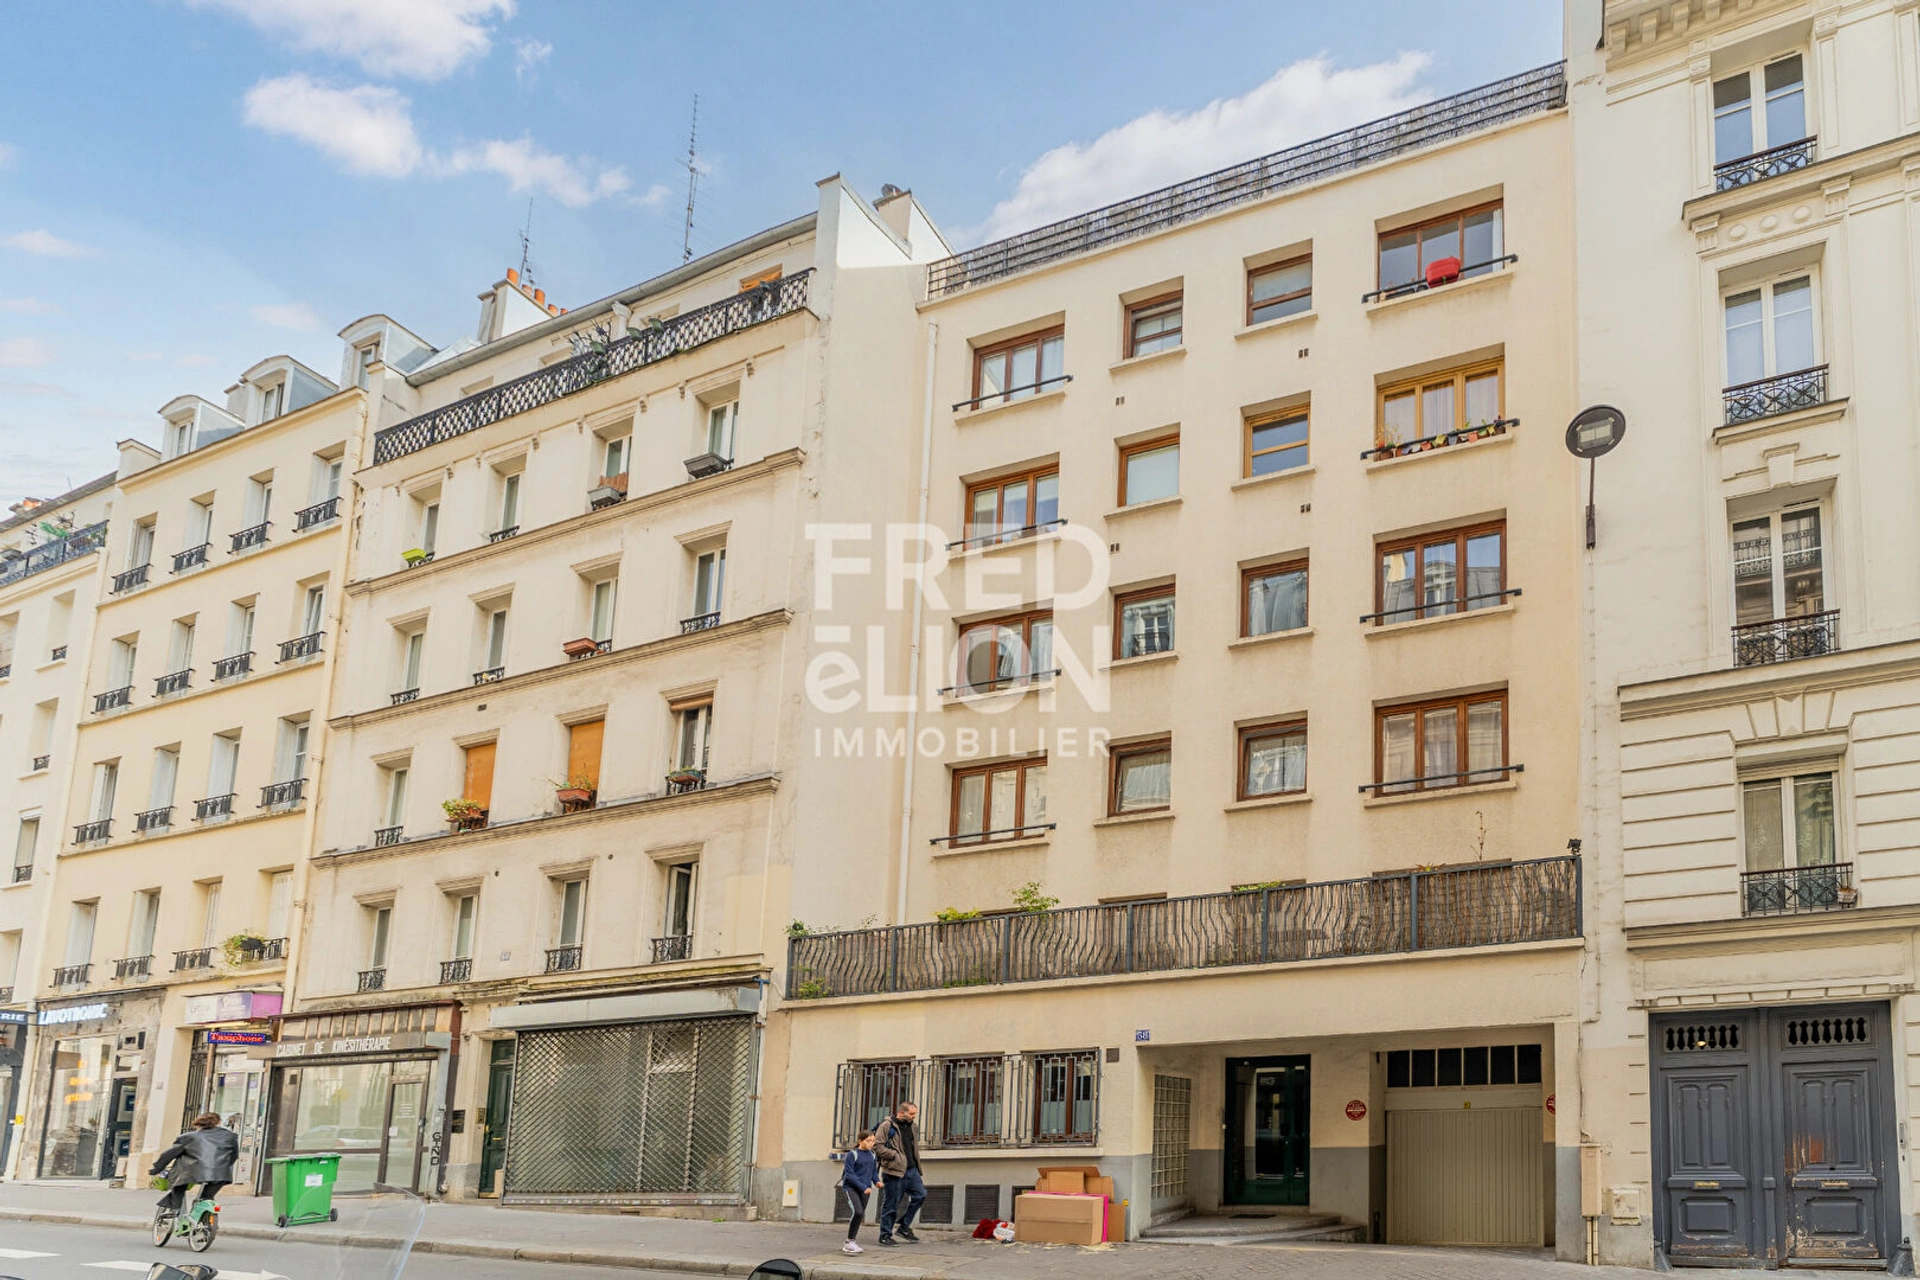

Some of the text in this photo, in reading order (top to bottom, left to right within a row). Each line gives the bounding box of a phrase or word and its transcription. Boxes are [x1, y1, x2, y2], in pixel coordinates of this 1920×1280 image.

[276, 1036, 392, 1057] CABINET DE KINÉSITHÉRAPIE
